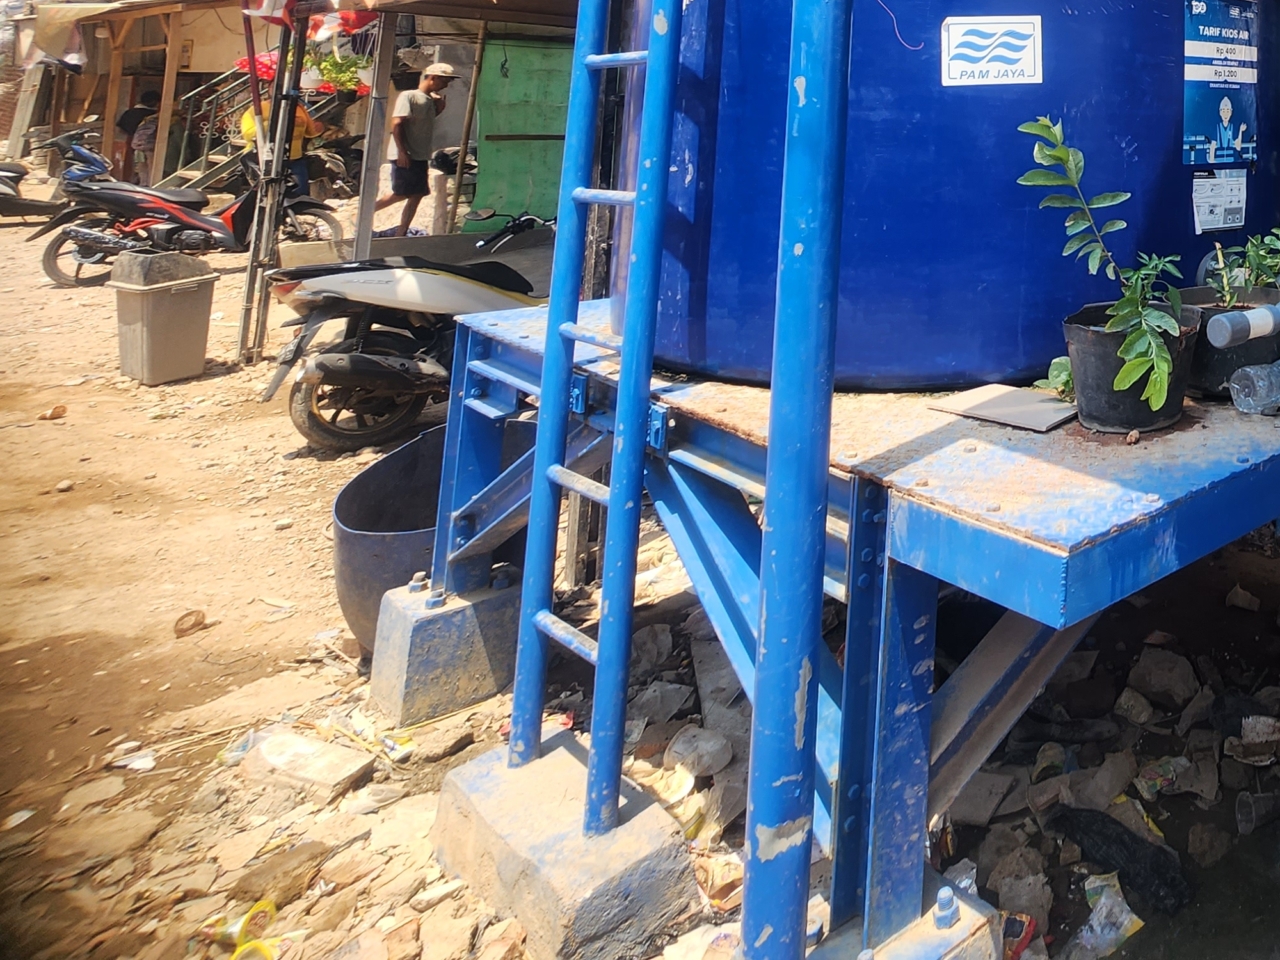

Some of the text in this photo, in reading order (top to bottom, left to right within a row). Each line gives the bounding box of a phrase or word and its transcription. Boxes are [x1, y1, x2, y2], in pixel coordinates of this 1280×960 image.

[1199, 26, 1221, 37] TARIF
[1222, 28, 1239, 39] KIOS
[1215, 46, 1237, 57] Rp 400
[959, 68, 1026, 80] PAM JAYA
